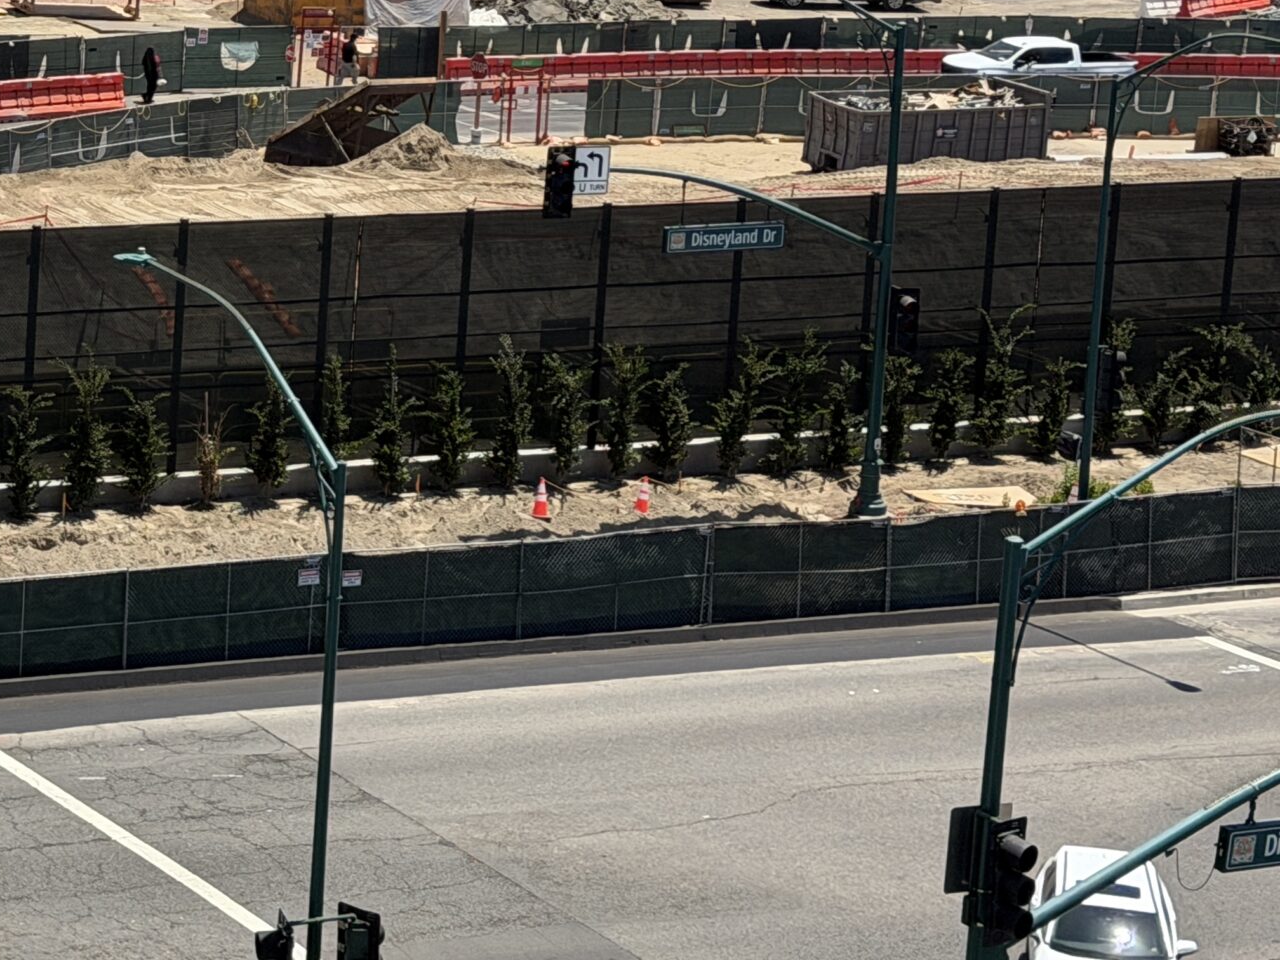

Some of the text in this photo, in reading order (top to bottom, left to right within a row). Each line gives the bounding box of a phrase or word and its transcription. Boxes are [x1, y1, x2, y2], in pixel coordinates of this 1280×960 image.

[471, 61, 488, 74] STOP
[579, 182, 605, 192] U TURN
[691, 228, 777, 248] Disneyland Dr
